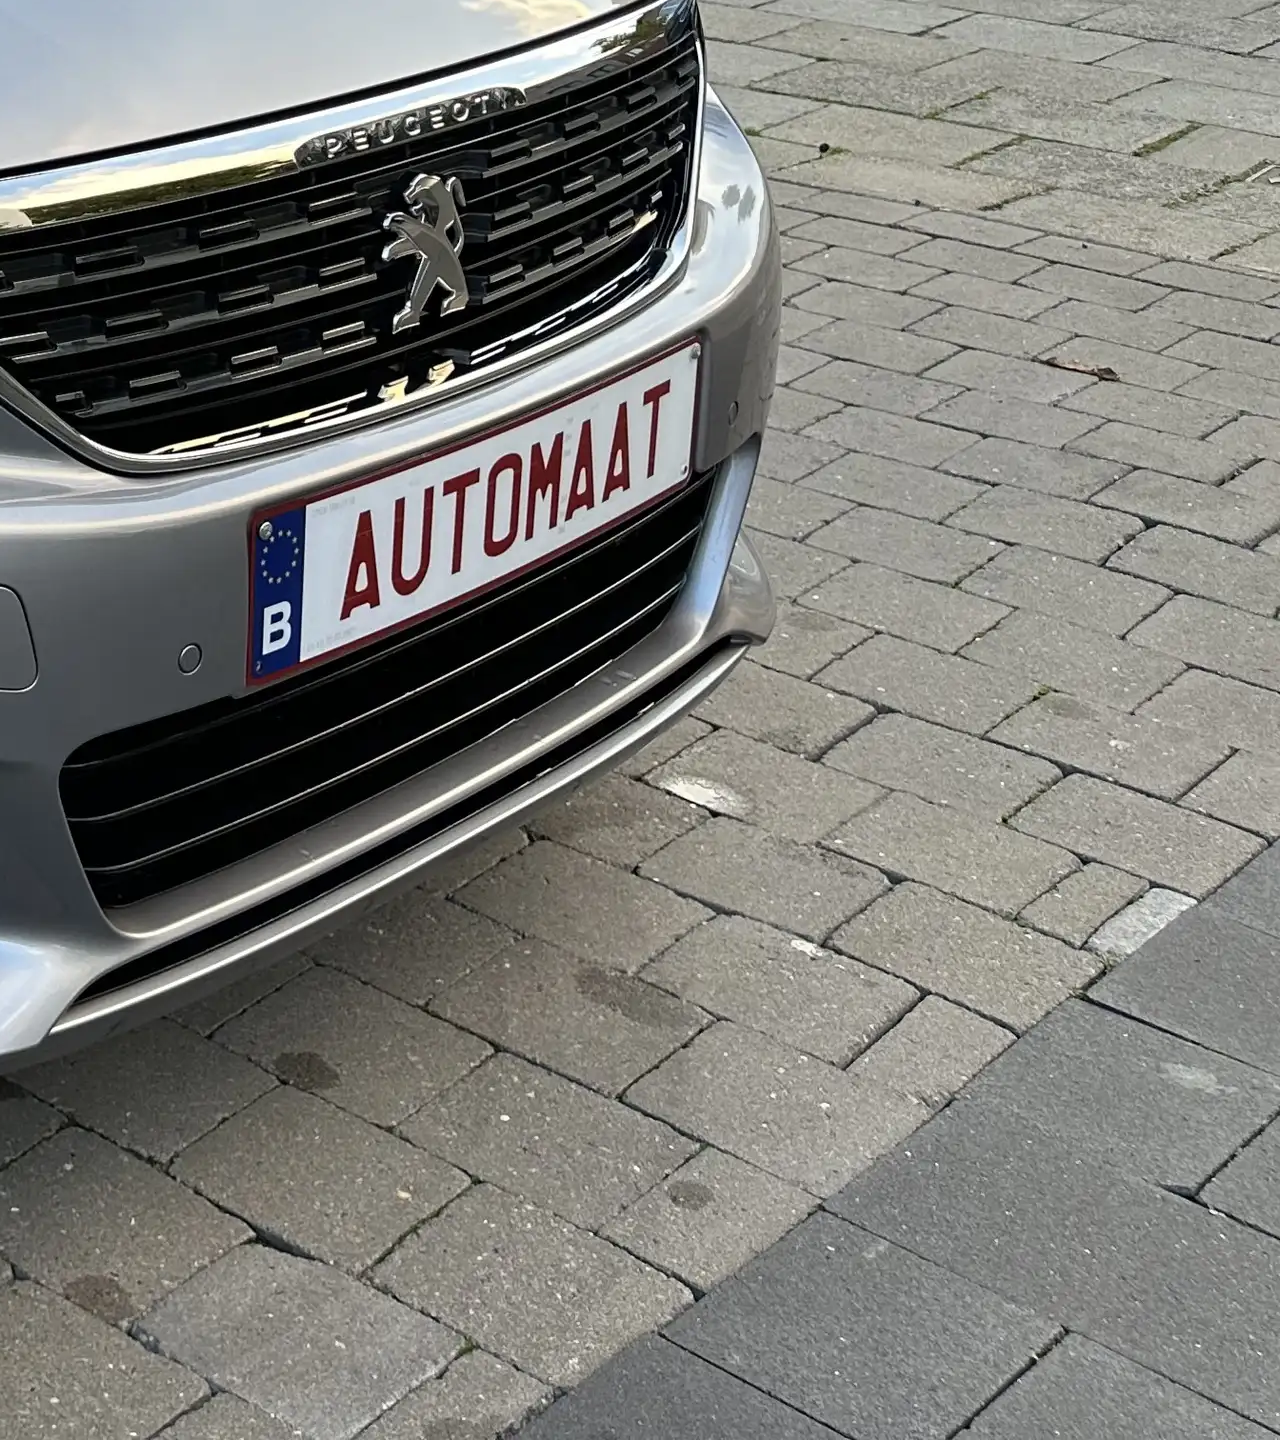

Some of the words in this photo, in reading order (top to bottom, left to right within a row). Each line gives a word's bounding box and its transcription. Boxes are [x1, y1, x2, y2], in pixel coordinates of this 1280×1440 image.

[325, 92, 490, 159] PEUGEOT
[340, 379, 671, 621] AUTOMAAT
[262, 600, 292, 656] B
